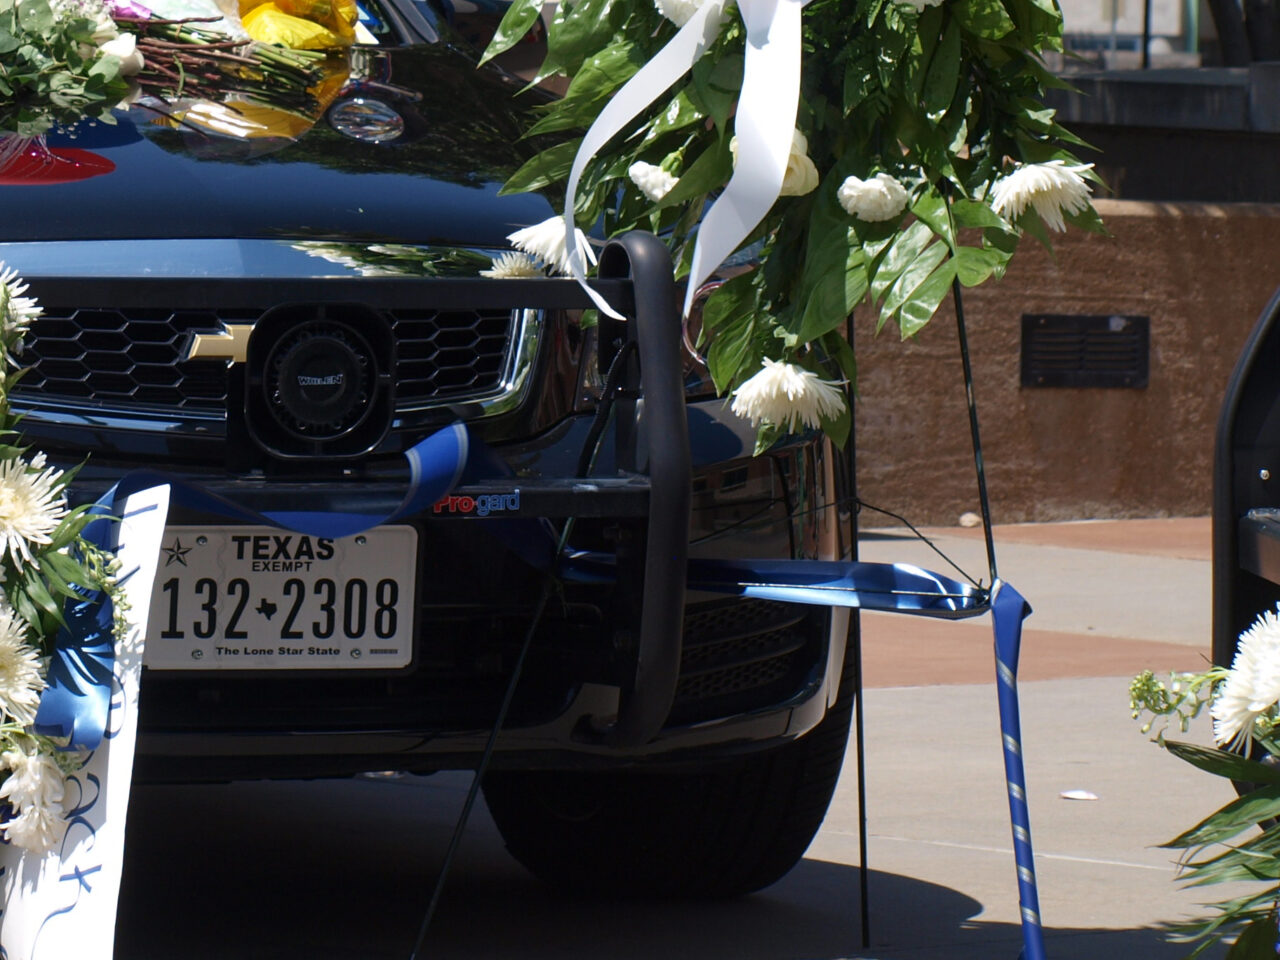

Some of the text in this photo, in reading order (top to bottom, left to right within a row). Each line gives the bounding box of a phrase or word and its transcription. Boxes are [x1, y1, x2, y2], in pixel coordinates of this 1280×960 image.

[232, 536, 335, 560] TEXAS
[252, 561, 313, 572] EXEMPT
[160, 577, 399, 639] 132 2308
[216, 646, 341, 656] The Lone Star State
